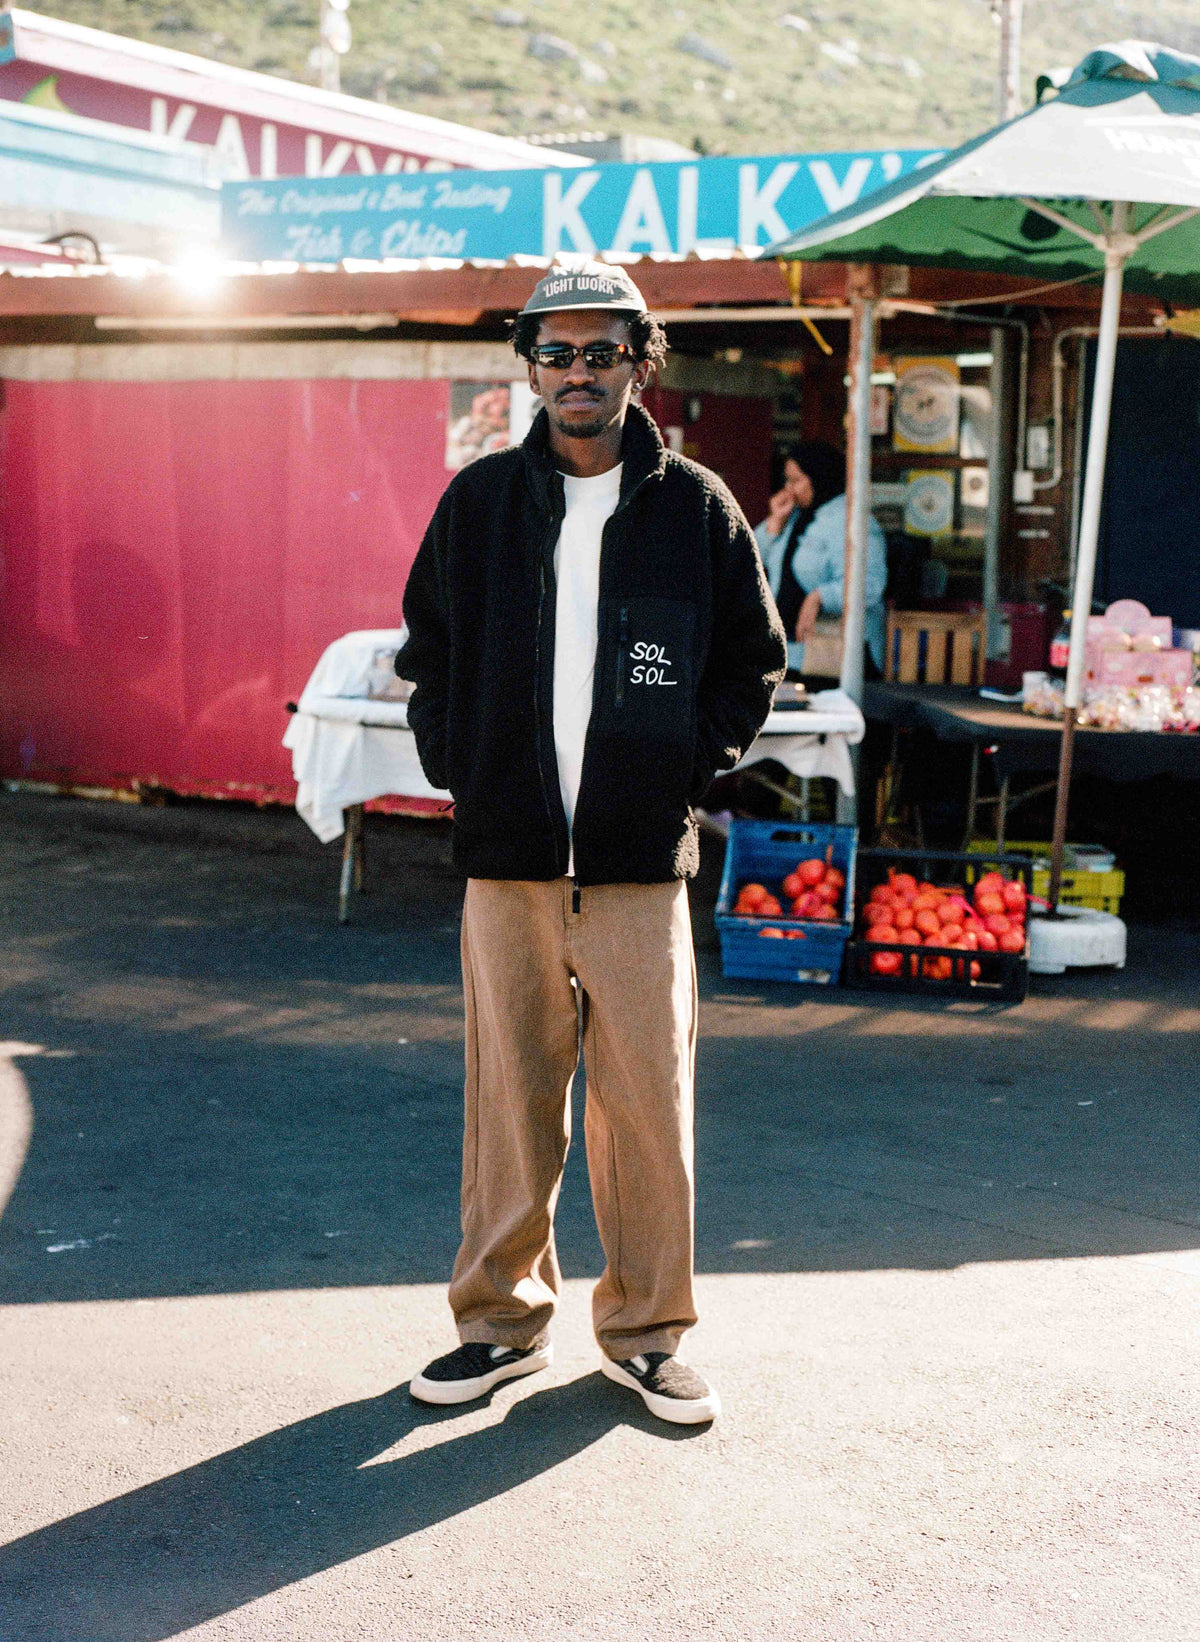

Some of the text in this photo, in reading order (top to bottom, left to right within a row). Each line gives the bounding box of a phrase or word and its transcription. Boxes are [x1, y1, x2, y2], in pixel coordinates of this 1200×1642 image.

[542, 153, 946, 258] KALKY'
[284, 223, 341, 258] Fish
[381, 220, 468, 256] Chips
[629, 641, 672, 666] SOL
[629, 665, 678, 685] SOL
